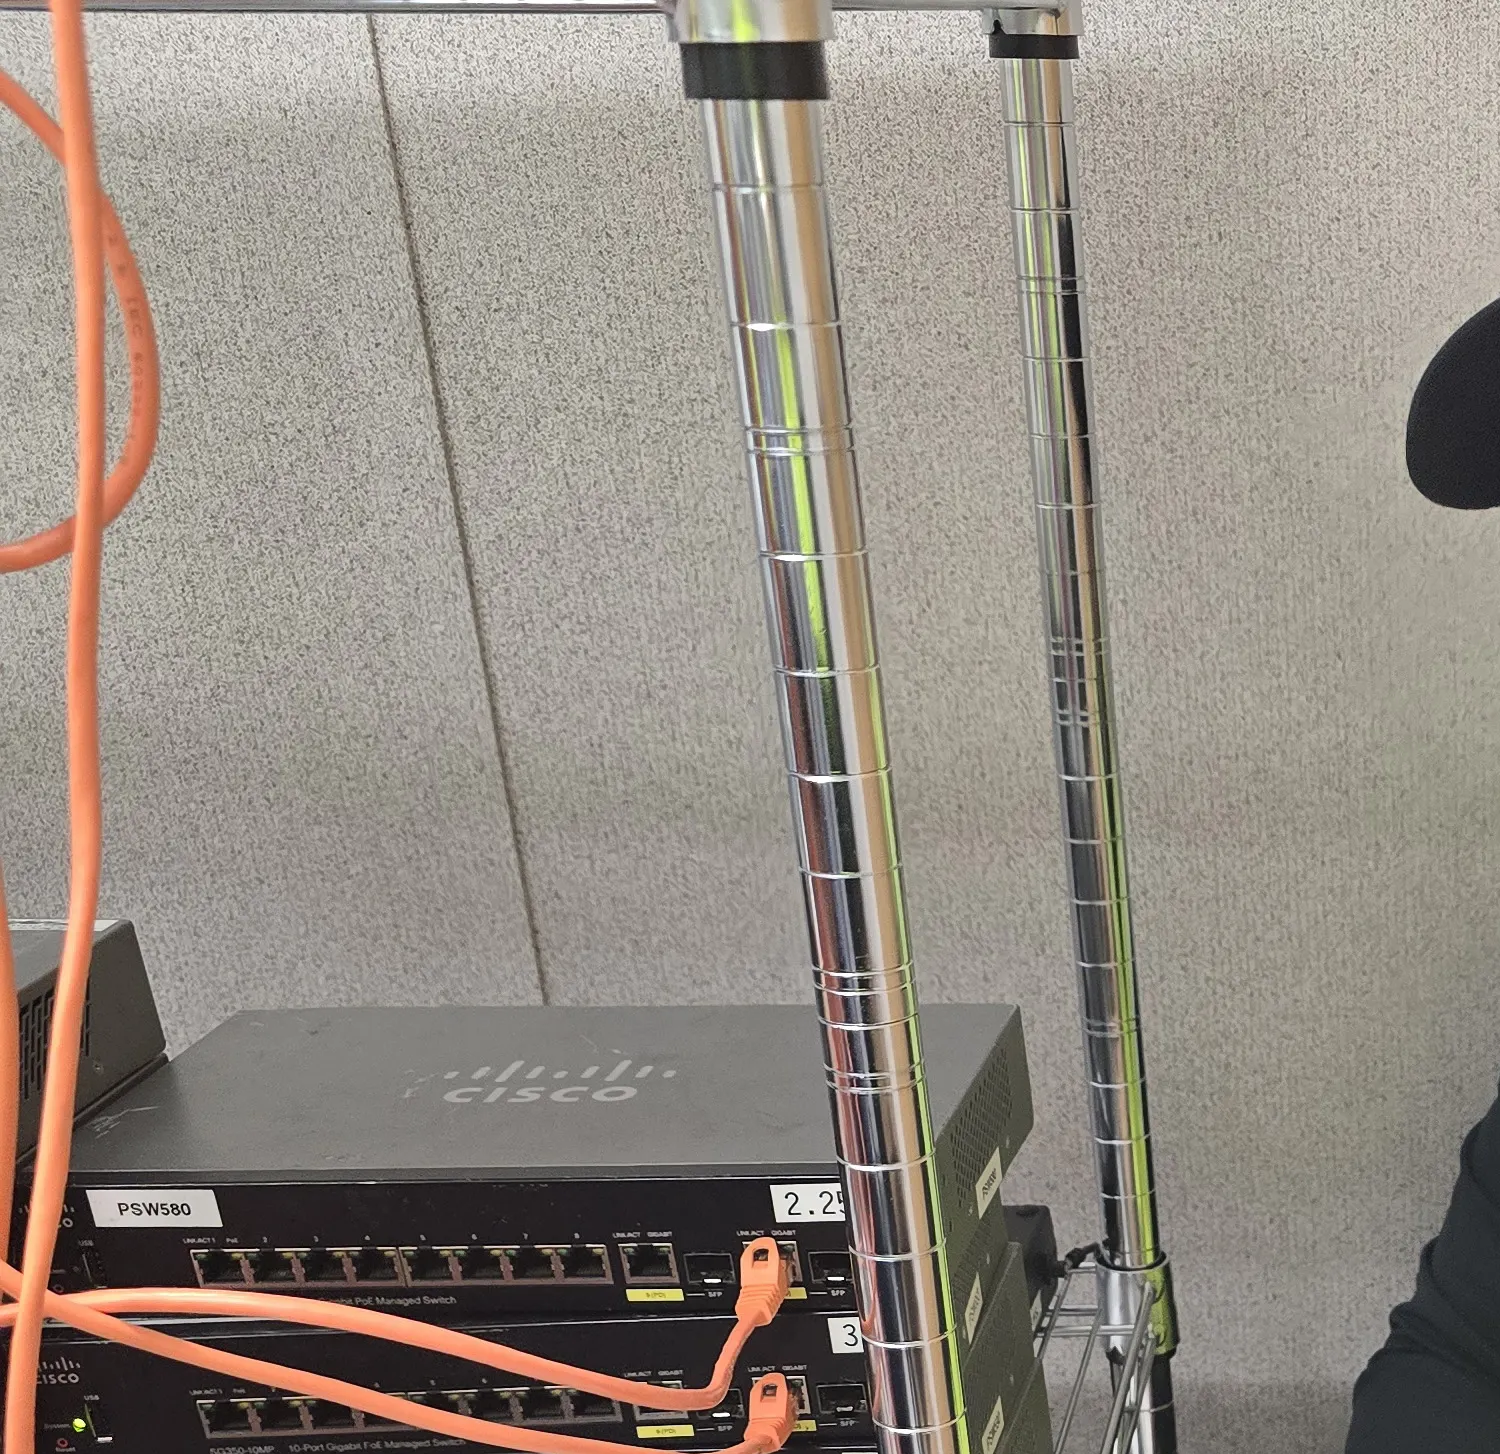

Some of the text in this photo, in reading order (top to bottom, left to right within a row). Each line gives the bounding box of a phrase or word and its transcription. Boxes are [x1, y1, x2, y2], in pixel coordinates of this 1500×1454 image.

[117, 1201, 192, 1218] PSW580
[375, 1296, 421, 1307] Managed
[423, 1295, 457, 1305] Switch
[842, 1323, 859, 1347] 3
[288, 1443, 324, 1453] 10-Port
[384, 1438, 432, 1451] Managed
